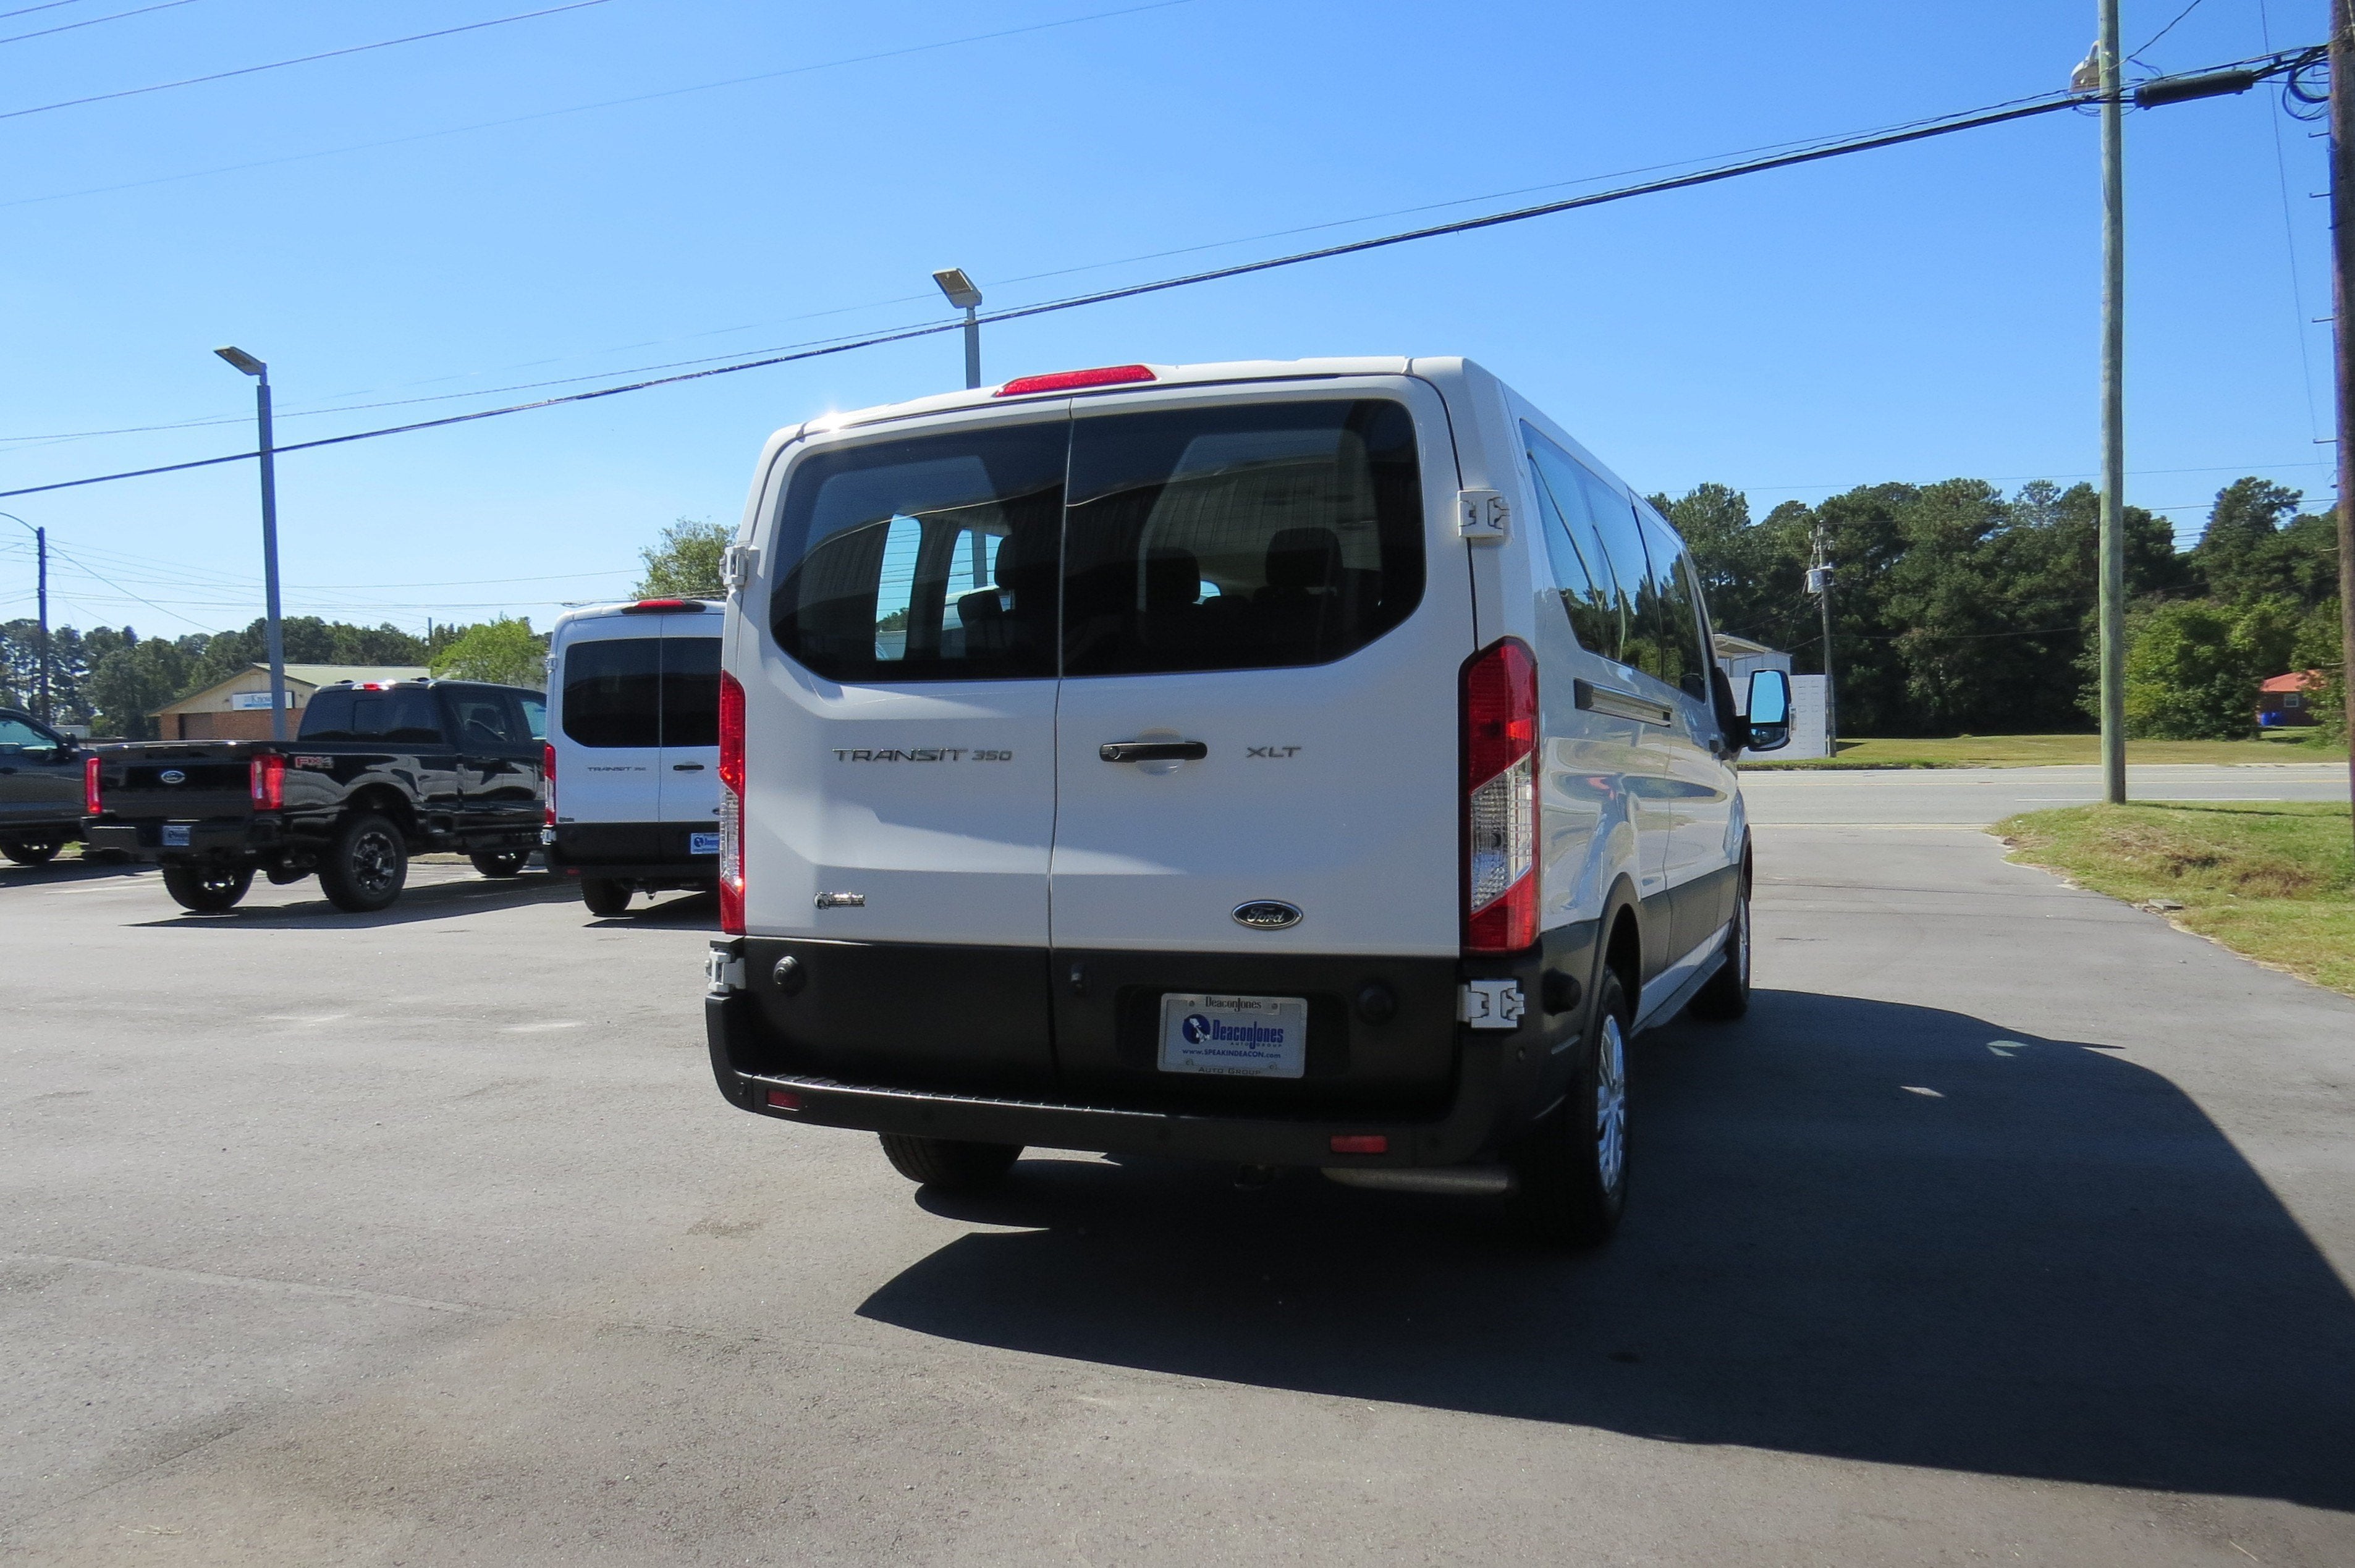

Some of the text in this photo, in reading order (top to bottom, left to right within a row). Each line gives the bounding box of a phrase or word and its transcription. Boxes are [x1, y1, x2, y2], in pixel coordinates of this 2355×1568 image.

[832, 748, 1013, 762] TRANSIT 350
[1246, 746, 1301, 758] XLT
[295, 756, 333, 769] FX4
[1246, 906, 1285, 924] Ford
[1182, 1048, 1281, 1059] www.SPEAKINDEACON.com
